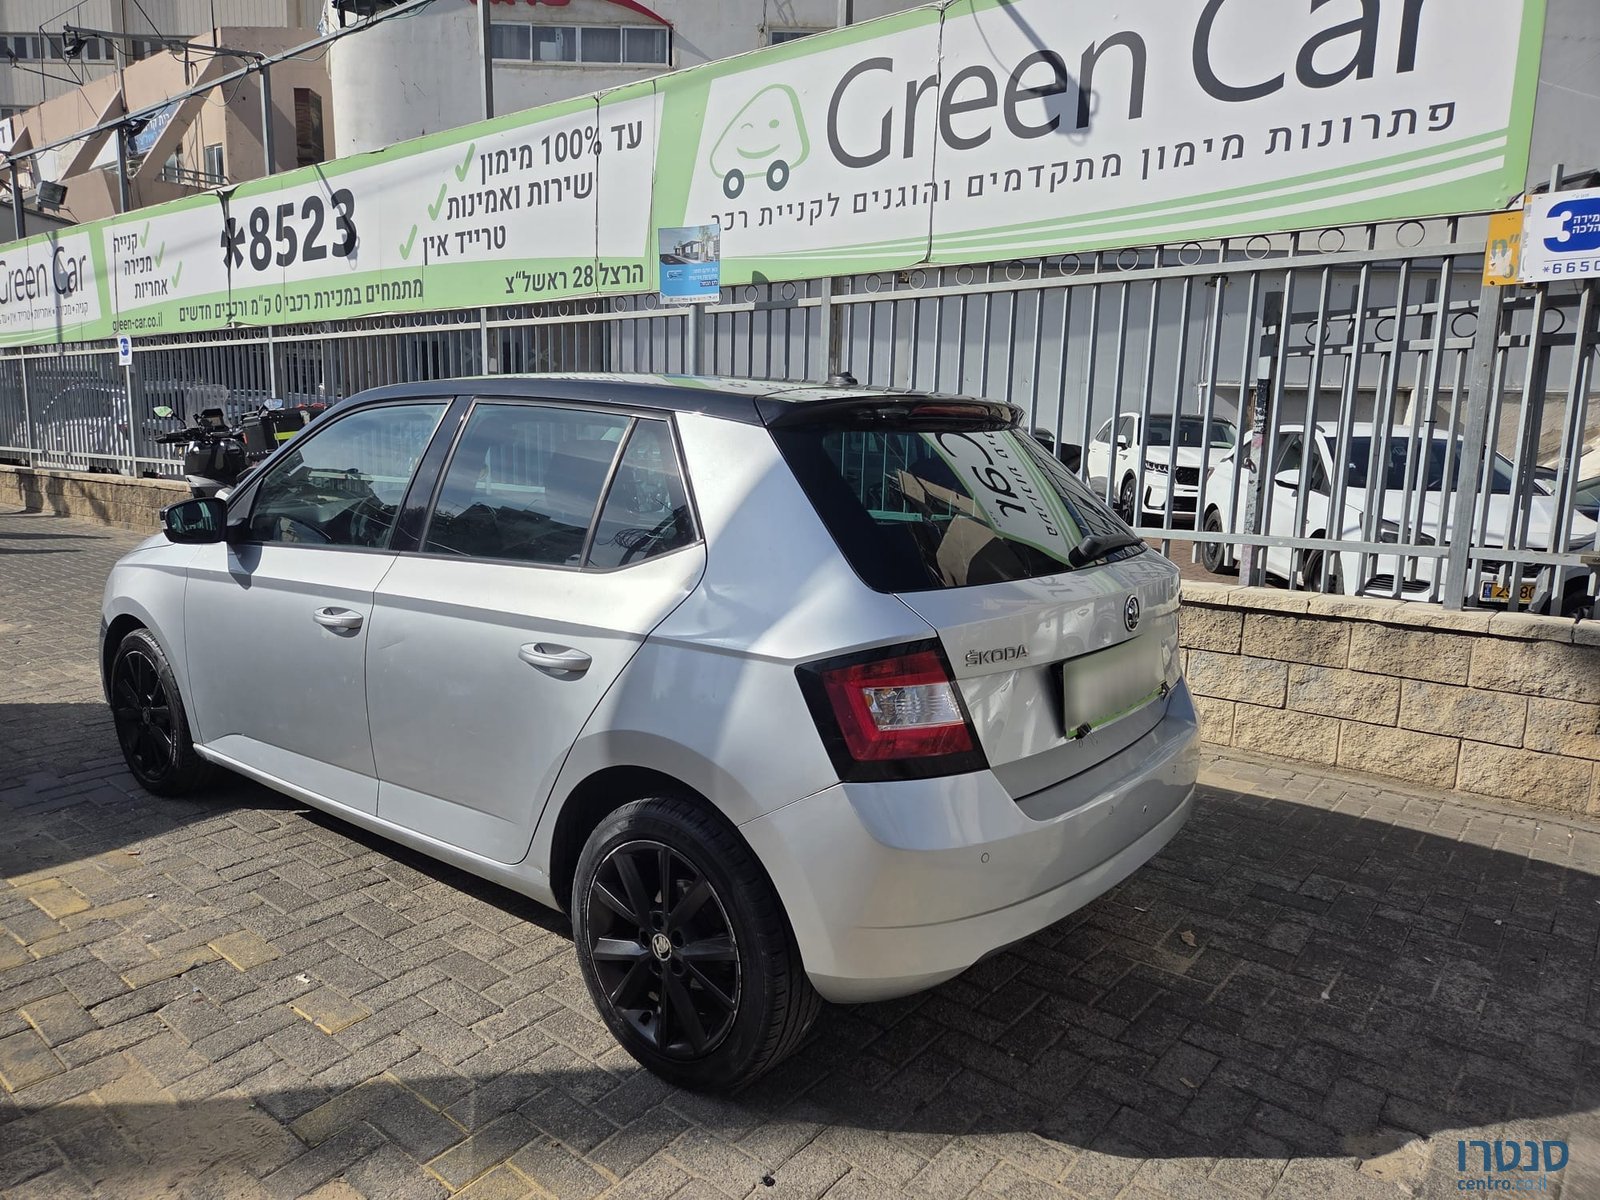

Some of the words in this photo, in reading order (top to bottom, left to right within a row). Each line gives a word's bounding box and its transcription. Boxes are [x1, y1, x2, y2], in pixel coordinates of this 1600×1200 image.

[827, 30, 1147, 169] Green
[1192, 0, 1427, 102] Car
[611, 120, 643, 151] עד
[1265, 101, 1456, 155] פתרונות
[541, 126, 602, 165] 100%
[1141, 132, 1245, 181] מימון
[480, 144, 533, 185] מימון
[967, 152, 1121, 198] מתקדמים
[447, 184, 521, 221] ואמינות
[527, 171, 593, 207] שירות
[852, 179, 951, 215] והוגנים
[758, 191, 840, 227] לקניית
[1572, 214, 1600, 224] מירה
[455, 225, 507, 254] טרייד
[1571, 223, 1600, 235] הלכה
[422, 233, 449, 266] אין
[52, 246, 87, 294] Car
[124, 255, 152, 276] מכירה
[572, 264, 594, 288] 28
[599, 262, 644, 286] הרצל
[134, 278, 168, 299] אחריות
[285, 294, 310, 312] רכבי
[314, 286, 361, 310] במכירת
[366, 279, 423, 303] מתמחים
[112, 311, 163, 332] green-car.co.il
[179, 304, 212, 322] חדשים
[214, 296, 248, 319] ורכבים
[964, 644, 1029, 667] ŠKODA
